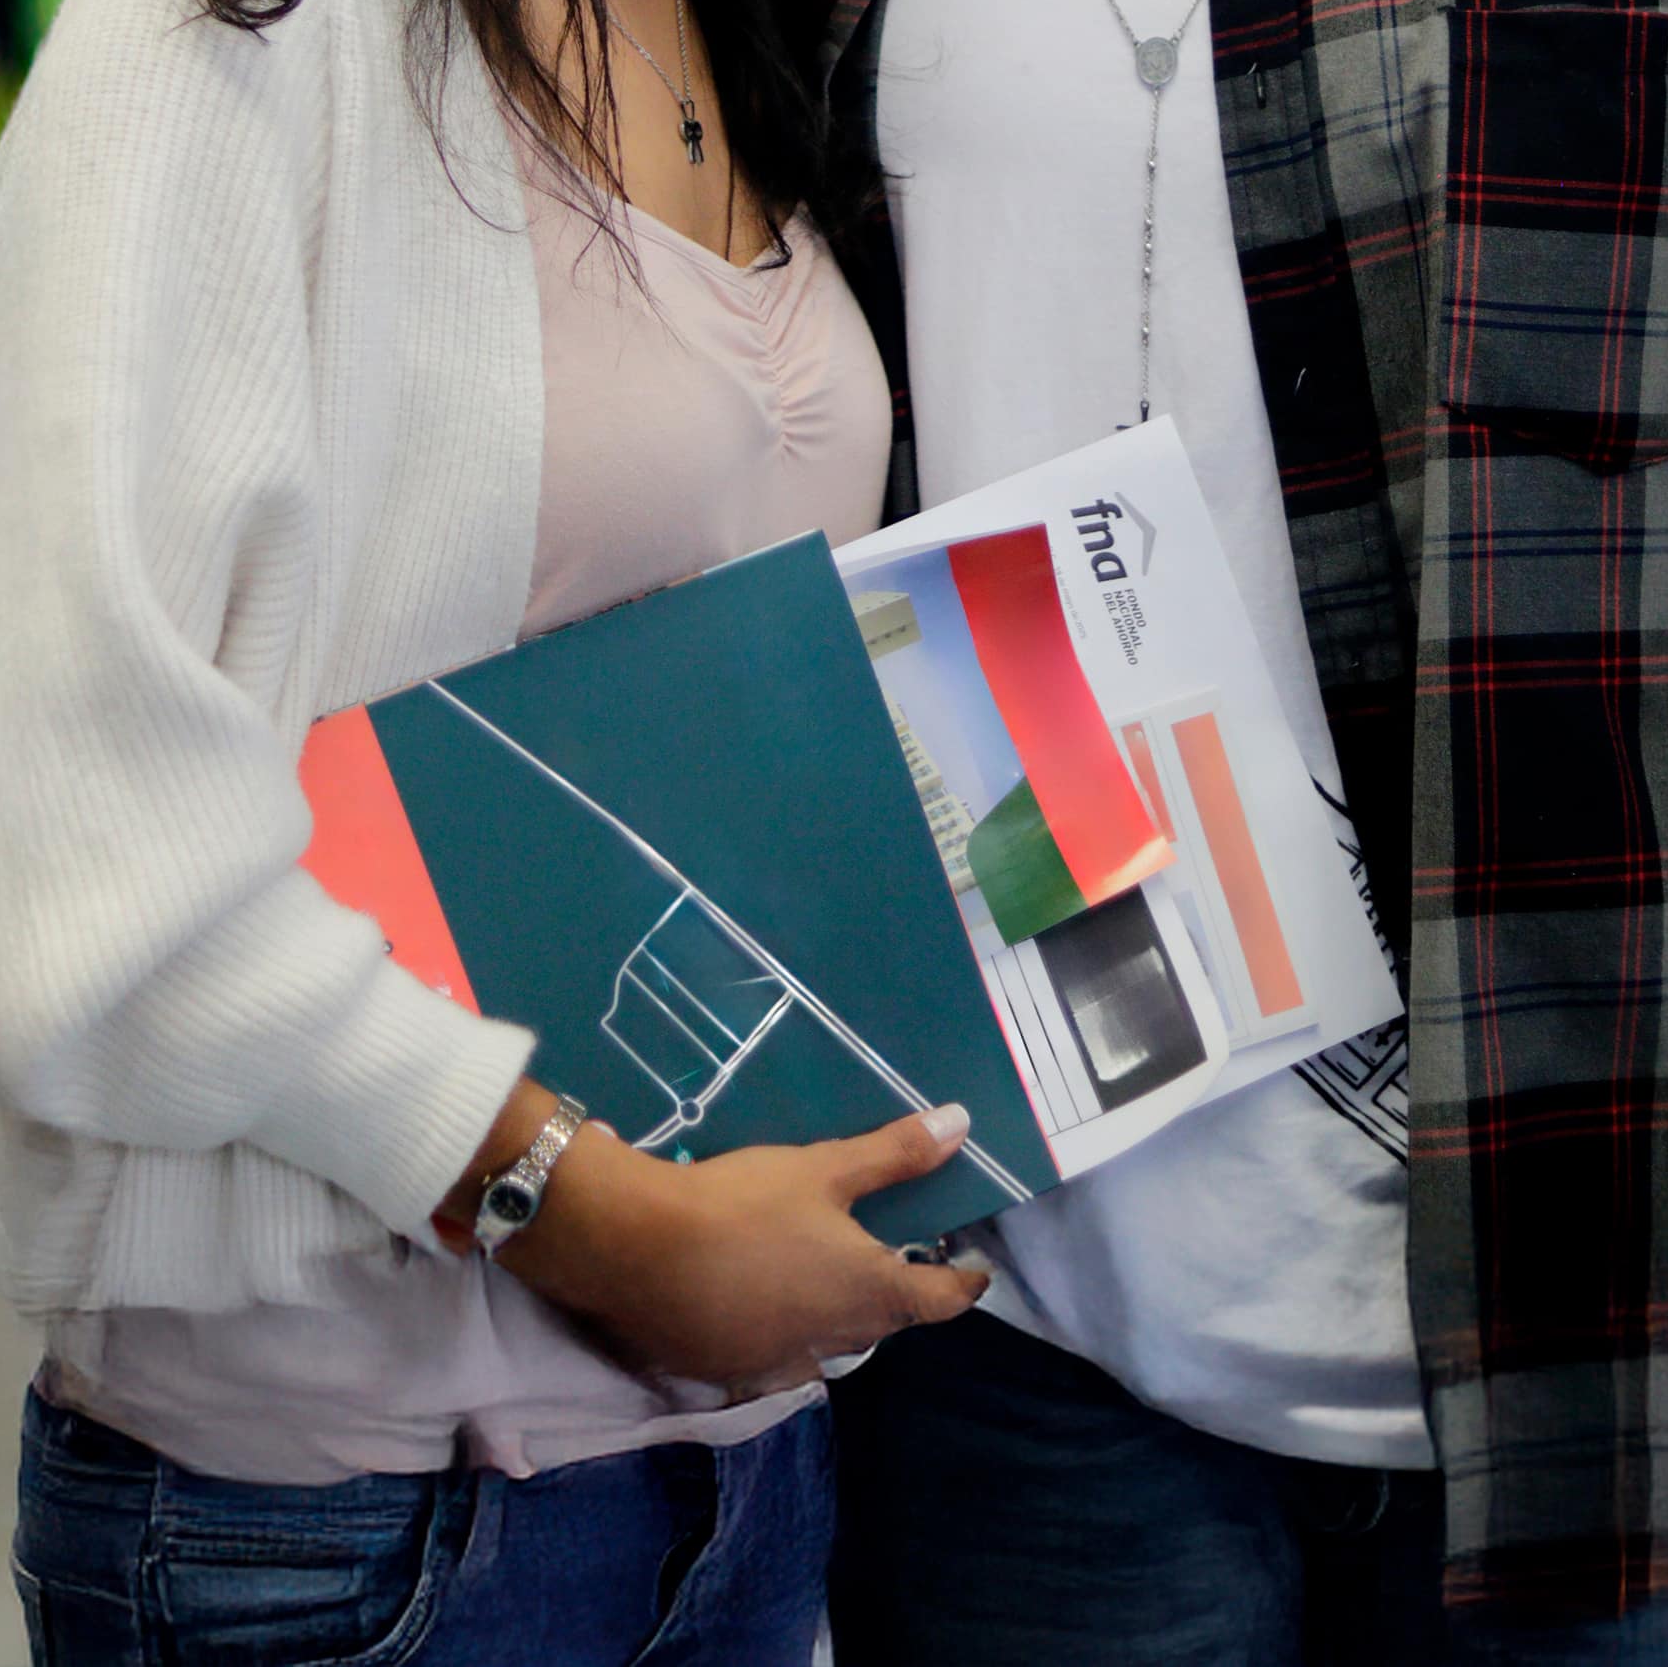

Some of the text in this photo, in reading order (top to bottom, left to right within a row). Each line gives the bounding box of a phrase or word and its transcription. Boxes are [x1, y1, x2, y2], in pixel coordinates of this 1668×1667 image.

[1070, 498, 1128, 583] fna
[1102, 592, 1139, 666] DEL AHORRO
[1113, 590, 1143, 650] NACIONAL
[1124, 588, 1147, 628] FONDO
